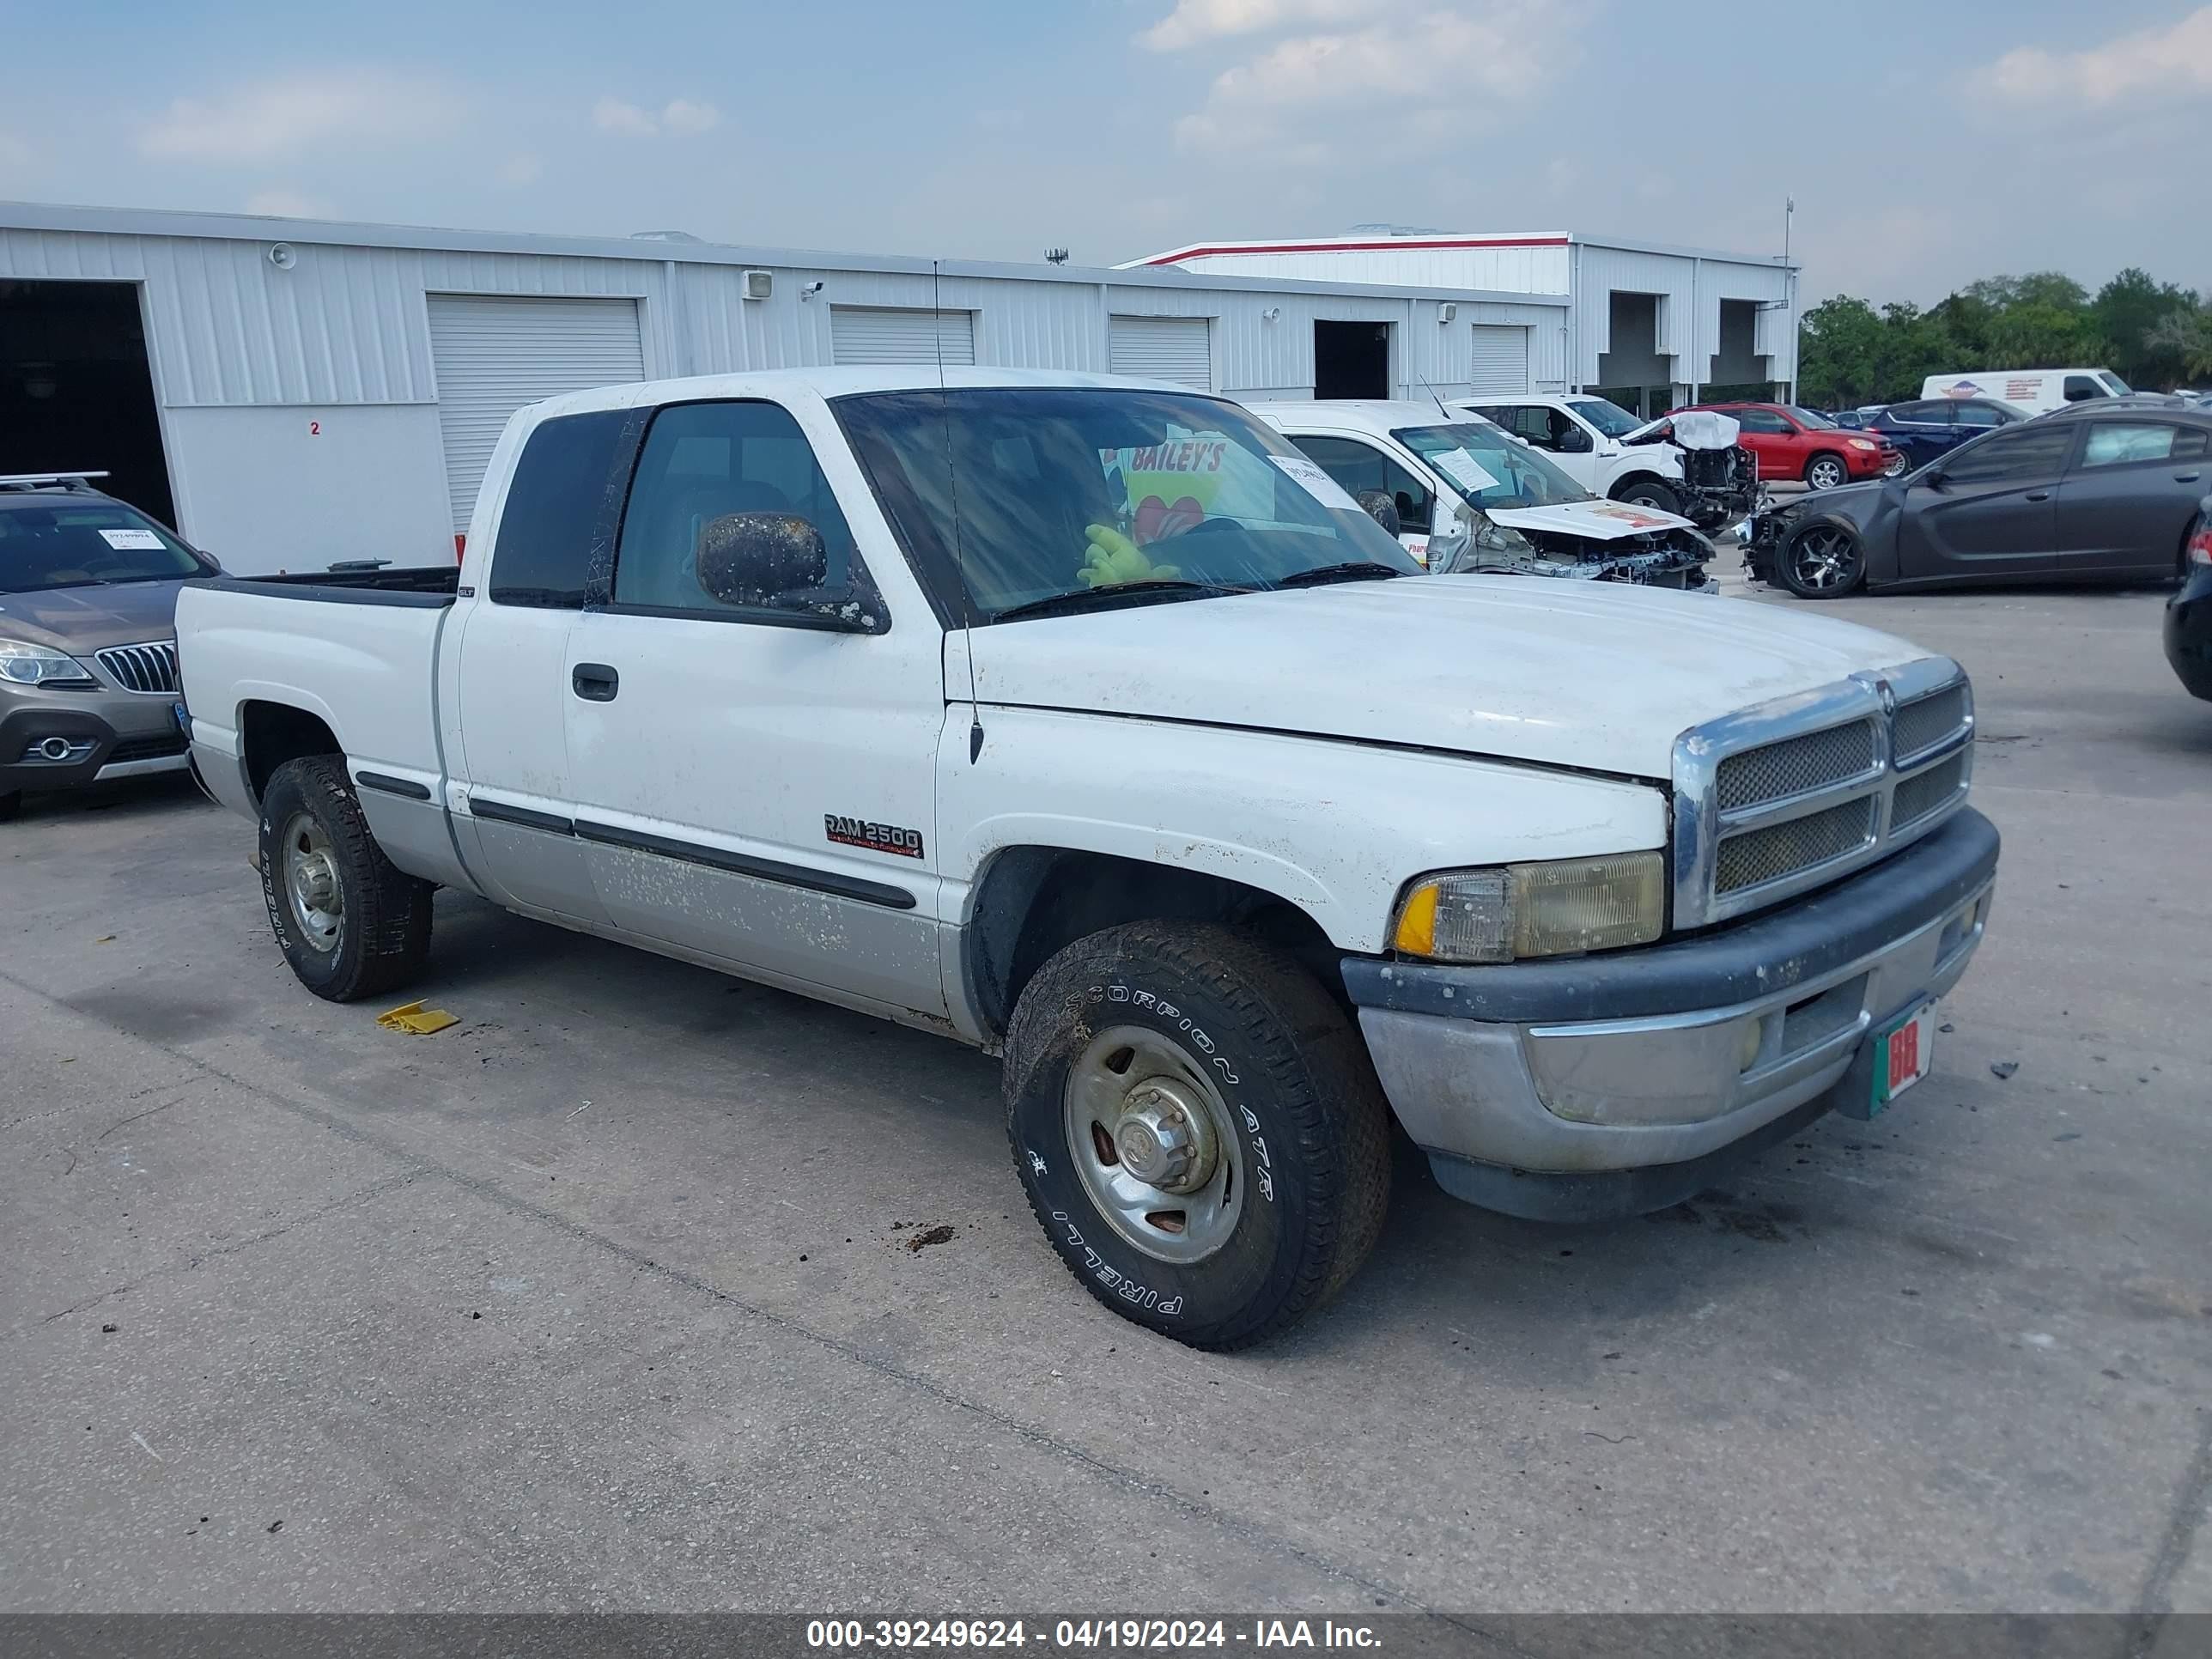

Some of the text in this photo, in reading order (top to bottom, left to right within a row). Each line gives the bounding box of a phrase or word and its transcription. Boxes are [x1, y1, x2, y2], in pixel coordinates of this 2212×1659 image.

[310, 422, 320, 435] 2
[1131, 442, 1226, 472] BAILEY'S
[824, 815, 862, 838] RAM
[866, 824, 920, 848] 2500
[261, 849, 292, 949] PIRELLI
[1065, 985, 1274, 1202] SCORPION ATR
[1052, 1211, 1184, 1316] PIRELLI
